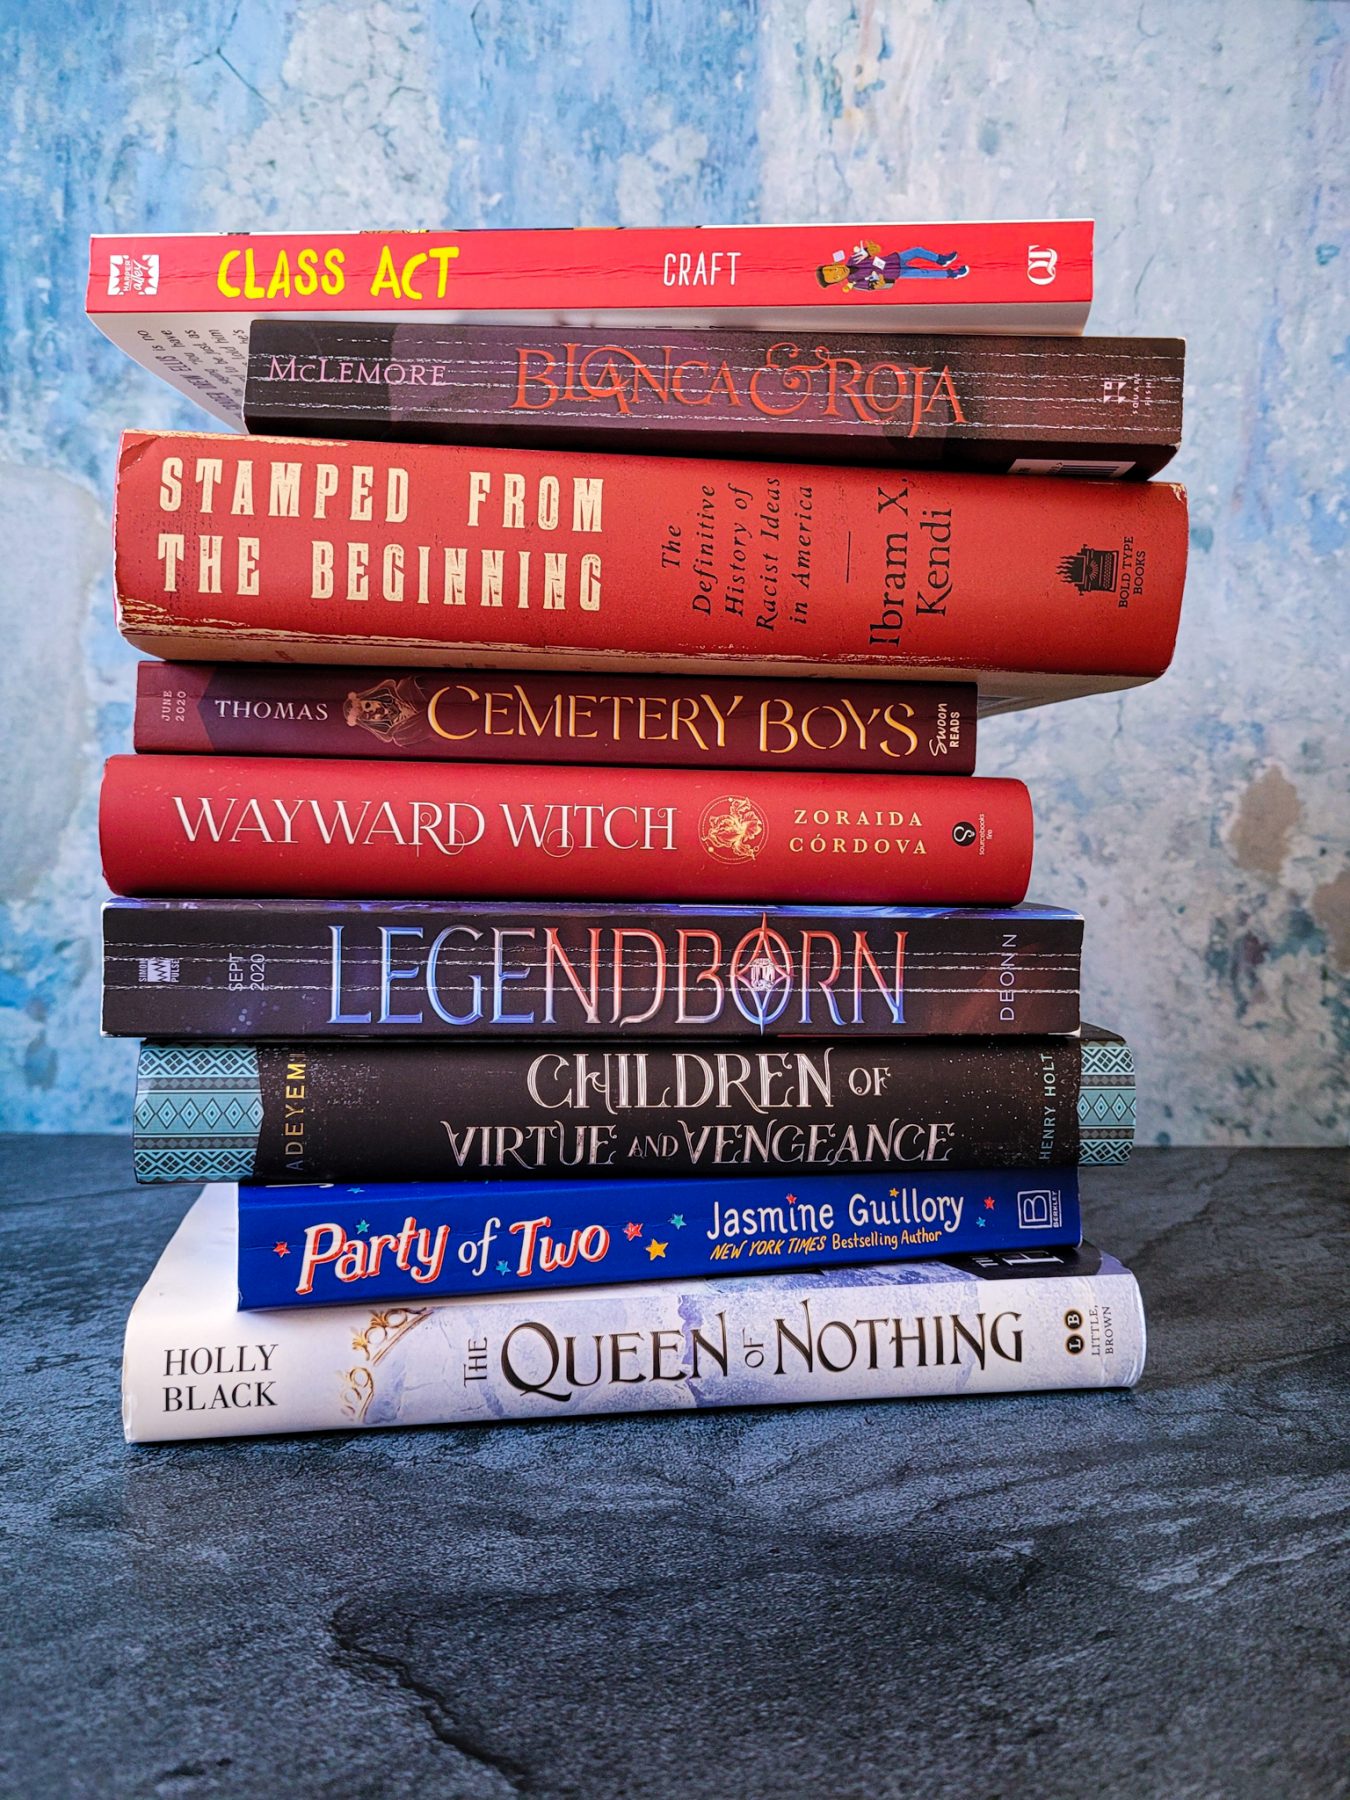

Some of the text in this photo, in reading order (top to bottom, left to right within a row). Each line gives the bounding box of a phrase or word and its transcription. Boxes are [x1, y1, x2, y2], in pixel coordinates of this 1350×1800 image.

[217, 246, 460, 300] CLASS ACT
[663, 251, 742, 286] CRAFT
[137, 330, 155, 341] no
[161, 330, 185, 347] have
[185, 329, 200, 339] as
[510, 342, 968, 438] BLANCA & ROJA
[159, 457, 604, 532] STAMPED FROM
[158, 533, 602, 611] THE BEGINNING
[661, 524, 682, 569] The
[692, 485, 718, 616] Definitive
[725, 483, 753, 617] History of
[756, 477, 780, 631] Racist Ideas
[789, 486, 813, 625] in America
[869, 477, 909, 648] Ibram X.
[915, 508, 953, 617] Kendi
[1118, 536, 1134, 608] BOLD TYPE
[1133, 550, 1146, 595] BOOKS
[161, 690, 172, 722] JUNE
[175, 691, 187, 722] 2020
[215, 700, 329, 721] THOMAS
[427, 684, 918, 757] CEMETERY BOYS
[929, 703, 947, 756] Swoon
[949, 711, 960, 748] READS
[172, 797, 677, 857] WAYWARD WITCH
[788, 832, 927, 855] CÓRDOVA
[794, 809, 923, 827] ZORAIDA
[171, 958, 180, 983] PULSE
[228, 952, 243, 992] SEPT
[250, 954, 265, 992] 2020
[326, 913, 909, 1034] LEGENDBORN
[1000, 933, 1018, 1022] DEONN
[527, 1047, 891, 1114] CHILDREN OF
[1038, 1053, 1057, 1160] HENRY HOLT
[284, 1053, 306, 1171] ADEYEMI
[440, 1118, 956, 1169] VIRTUE AND VENGEANCE
[706, 1187, 964, 1240] Jasmine Guillory
[295, 1215, 611, 1295] Party of Two
[710, 1228, 942, 1260] NEW YORK TIMES Bestselling Author
[463, 1298, 1024, 1402] THE QUEEN OF NOTHING
[1089, 1304, 1101, 1356] LITTLE,
[1102, 1306, 1114, 1355] BROWN
[163, 1343, 279, 1378] HOLLY
[161, 1381, 279, 1413] BLACK
